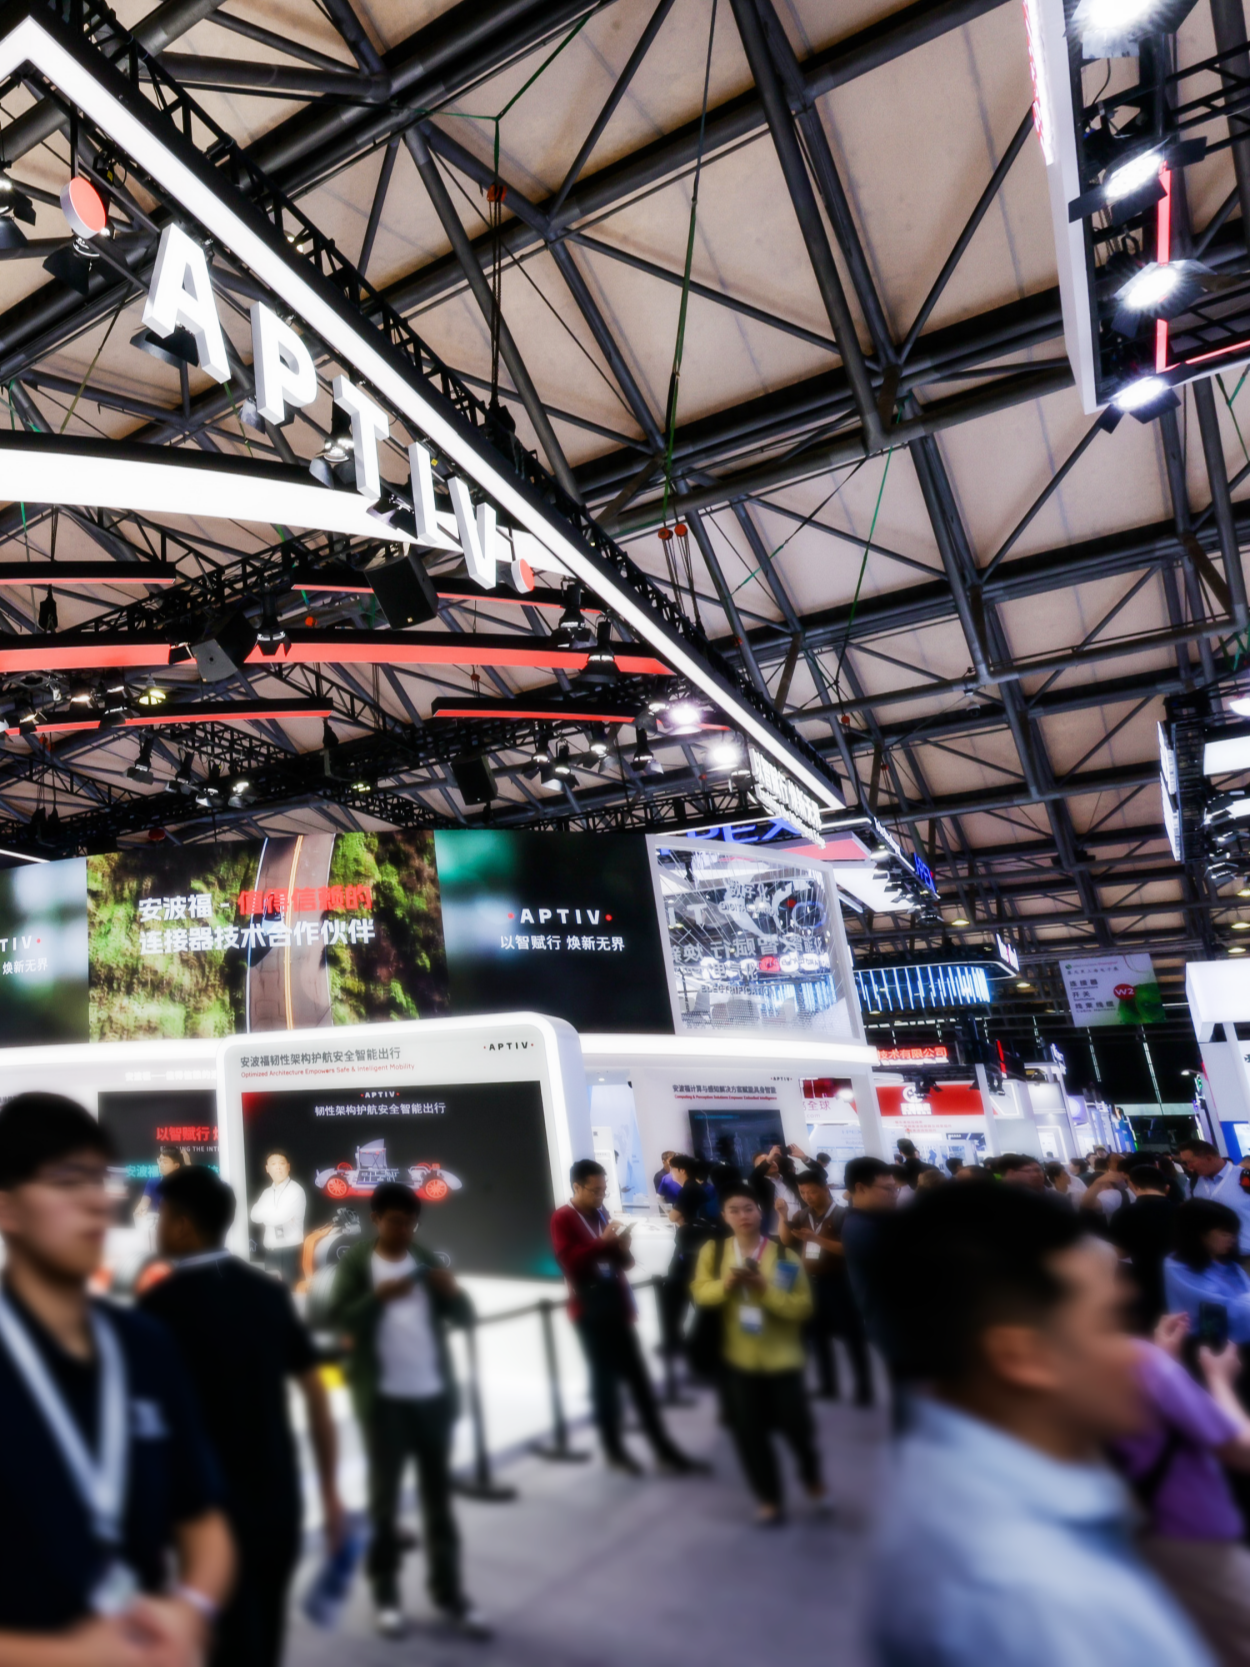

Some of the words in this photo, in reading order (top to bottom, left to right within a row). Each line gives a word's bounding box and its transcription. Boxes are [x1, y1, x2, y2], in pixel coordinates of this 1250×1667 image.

[142, 222, 497, 590] APTIV
[138, 893, 213, 922] 安波福
[238, 884, 373, 915] 值得信赖的
[520, 908, 600, 925] APTIV
[139, 918, 376, 955] 连接器技术合作伙伴
[500, 935, 561, 950] 以智赋行
[566, 935, 625, 952] 焕新无界
[2, 957, 48, 975] 焕新无界
[1115, 987, 1135, 996] W2
[489, 1041, 528, 1051] APTIV
[240, 1047, 400, 1068] 安波福韧性架构护航安全智能出行
[241, 1071, 268, 1079] Optimized
[269, 1068, 304, 1077] Architecture
[305, 1067, 335, 1075] Empowers
[389, 1063, 415, 1071] Mobility
[315, 1102, 446, 1117] 韧性架构护航安全智能出行
[156, 1126, 210, 1142] 以智赋行
